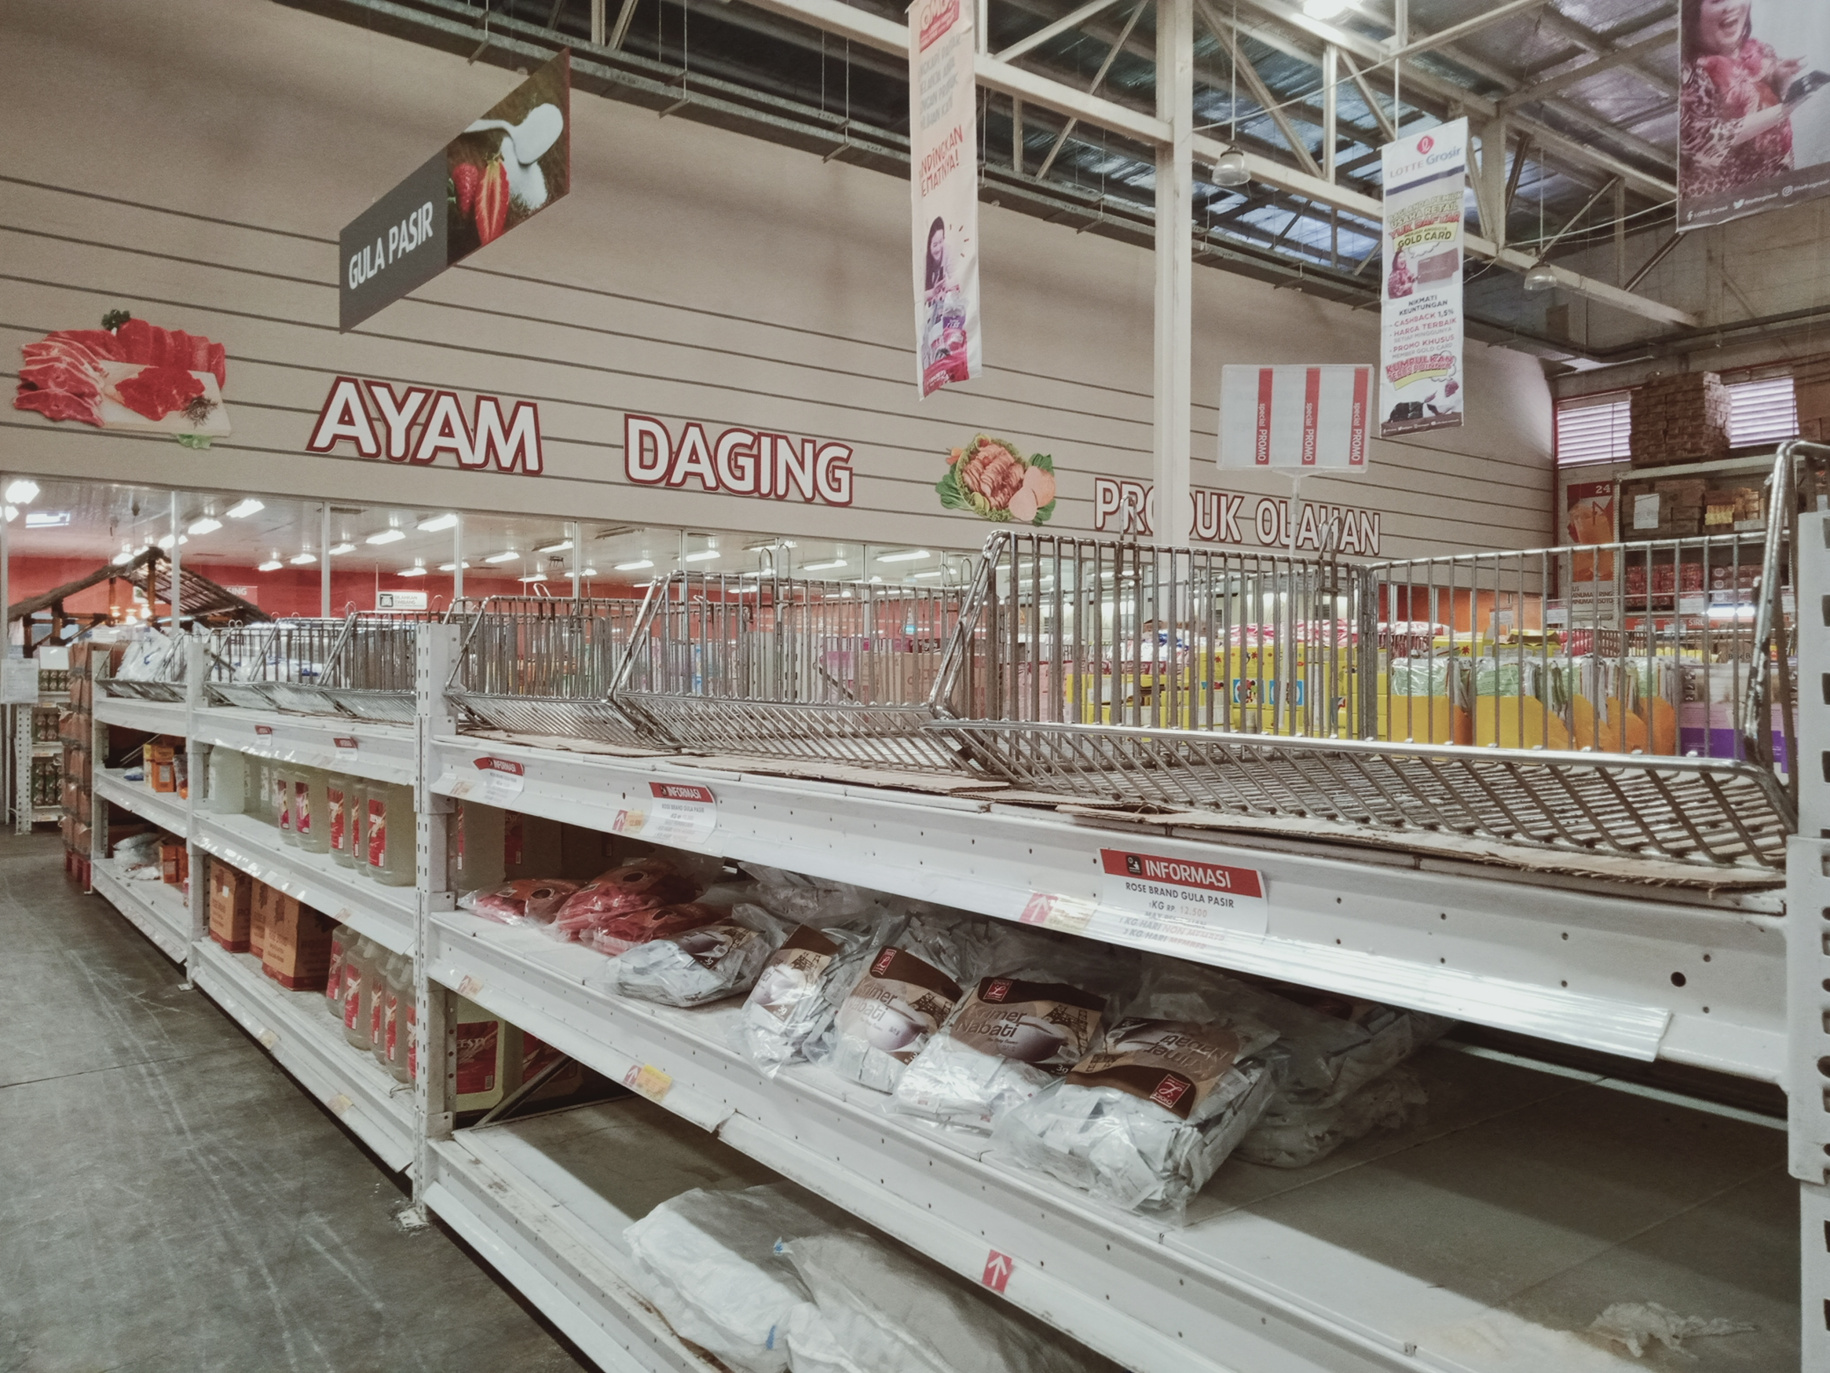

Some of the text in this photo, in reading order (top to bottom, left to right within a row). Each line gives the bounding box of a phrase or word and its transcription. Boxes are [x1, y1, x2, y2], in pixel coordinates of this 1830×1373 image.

[1390, 146, 1462, 178] LOTTE Grosir
[1390, 200, 1458, 229] USAHA RETAIL
[349, 201, 433, 289] GULA PASIR
[1398, 231, 1452, 247] GOLD CARD
[1399, 300, 1448, 316] KEUNTUNGAN
[1408, 295, 1437, 306] NIKMATI
[1394, 312, 1436, 327] CASHBACK
[1394, 318, 1457, 337] HARGA TERBAIK
[1393, 335, 1455, 352] PROMO KHUSUS
[1417, 346, 1435, 354] GOLD
[1436, 342, 1453, 350] CARD
[1386, 355, 1454, 373] KUMPULKAN
[305, 374, 543, 476] AYAM
[1257, 429, 1268, 461] PROMO
[1304, 429, 1314, 461] PROMO
[1351, 429, 1362, 461] PROMO
[623, 413, 853, 507] DAGING
[1596, 484, 1611, 494] 24
[1095, 477, 1245, 543] PRUK
[668, 786, 702, 799] INFORMASI
[1145, 859, 1231, 888] INFORMASI
[1126, 882, 1234, 908] ROSE BRAND GULA PASIR
[1180, 905, 1208, 918] 12.500
[1124, 918, 1139, 926] KG
[1139, 920, 1162, 931] HARI
[1129, 929, 1144, 938] KG
[967, 1004, 1027, 1023] Krimer
[955, 1018, 1019, 1038] Nabati
